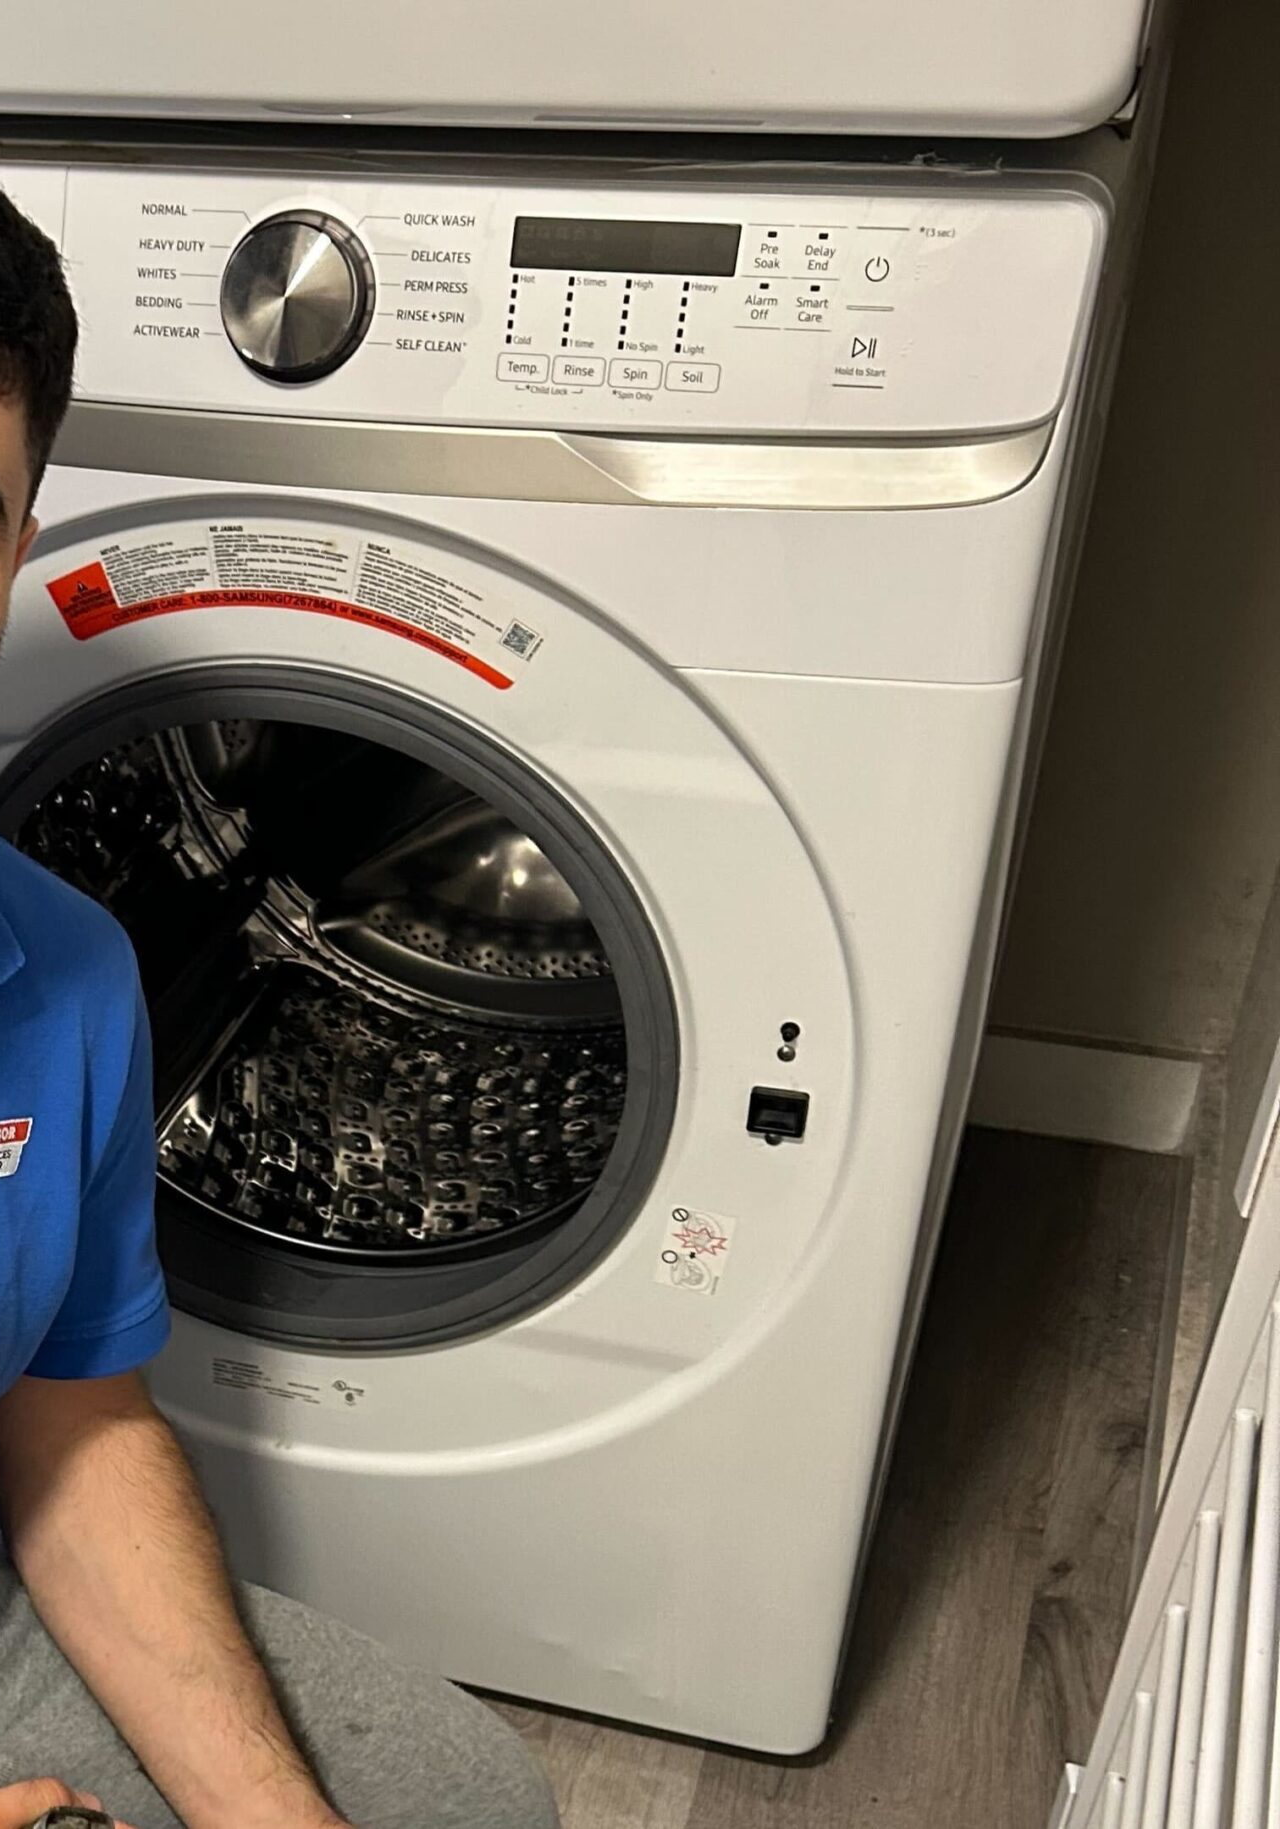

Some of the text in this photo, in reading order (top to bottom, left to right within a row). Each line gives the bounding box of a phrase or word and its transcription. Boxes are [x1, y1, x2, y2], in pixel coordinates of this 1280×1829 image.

[141, 204, 188, 217] NORMAL
[403, 213, 476, 228] QUICK WASH
[139, 238, 205, 252] HEAVY DUTY
[760, 243, 779, 255] Pre
[410, 250, 471, 264] DELICATES
[804, 245, 836, 259] Delay
[754, 258, 780, 269] Soak
[807, 260, 829, 271] End
[137, 268, 177, 280] WHITES
[520, 274, 535, 284] Hot
[404, 280, 468, 294] PERM PRESS
[583, 277, 607, 287] times
[633, 279, 654, 290] High
[691, 282, 718, 293] Heavy
[135, 296, 183, 309] BEDDING
[745, 295, 778, 307] Alarm
[796, 297, 829, 309] Smart
[750, 309, 769, 320] Off
[797, 311, 823, 323] Care
[133, 325, 200, 339] ACTIVEWEAR
[396, 338, 422, 351] SELF
[513, 335, 532, 345] Cold
[574, 339, 594, 349] time
[625, 342, 659, 353] No Spin
[682, 345, 705, 355] Light
[507, 360, 540, 374] Temp.
[564, 364, 595, 377] Rinse
[834, 366, 886, 378] Hold to Start
[623, 368, 648, 381] Spin
[682, 371, 704, 384] Soil
[550, 386, 568, 396] Lock
[634, 391, 653, 402] Only
